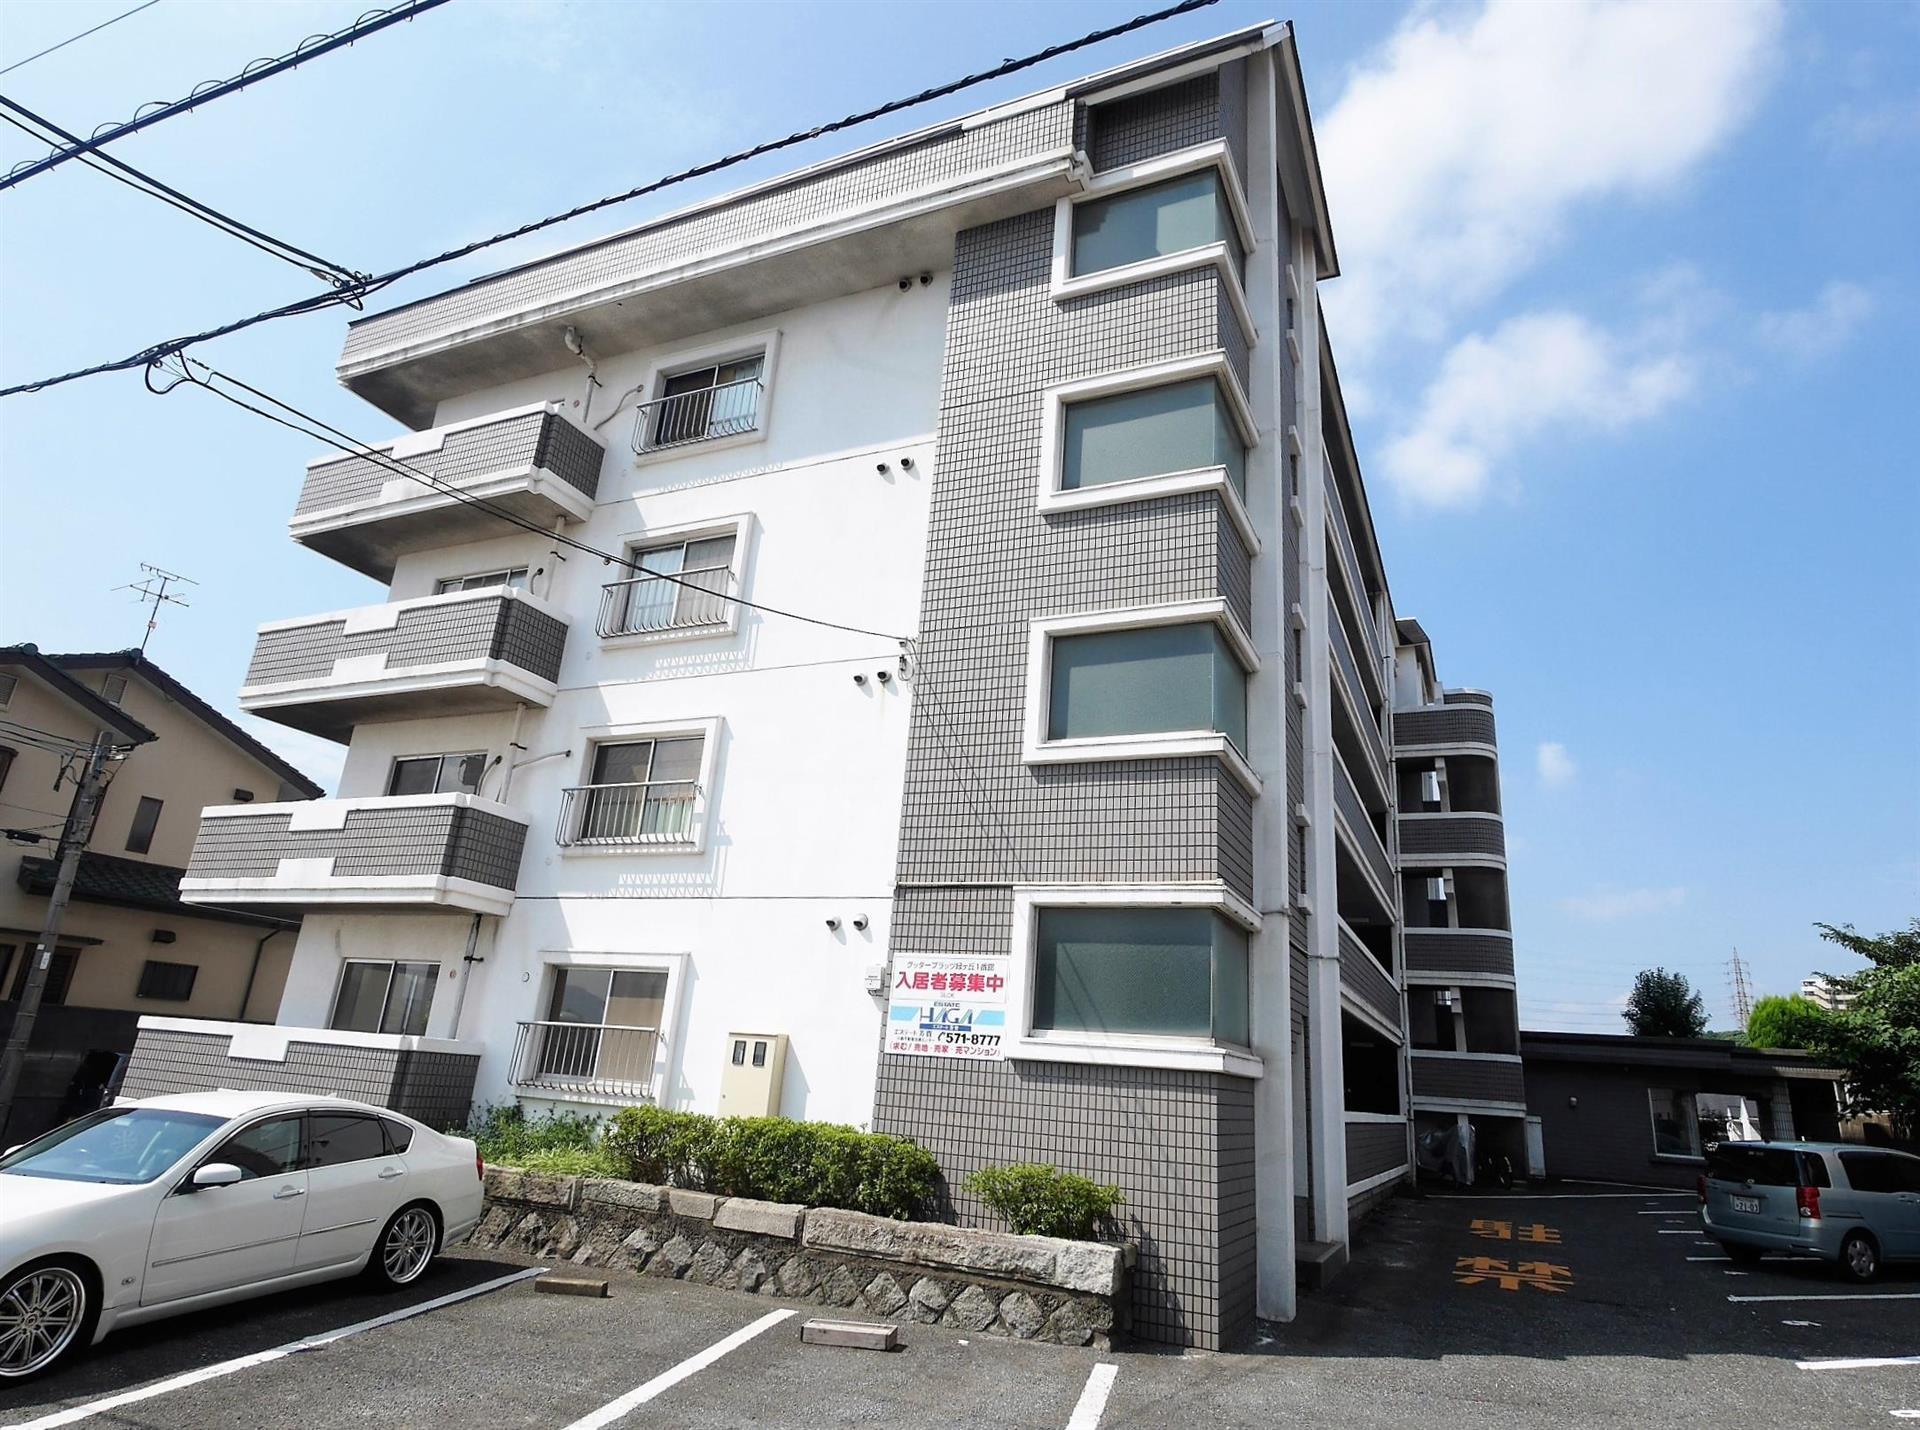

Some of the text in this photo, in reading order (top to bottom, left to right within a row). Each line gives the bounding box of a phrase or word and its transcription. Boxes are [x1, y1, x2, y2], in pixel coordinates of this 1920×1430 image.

[895, 972, 1004, 993] 入居者募集中
[919, 1007, 974, 1025] HAGA
[945, 1032, 1001, 1046] 571-8777
